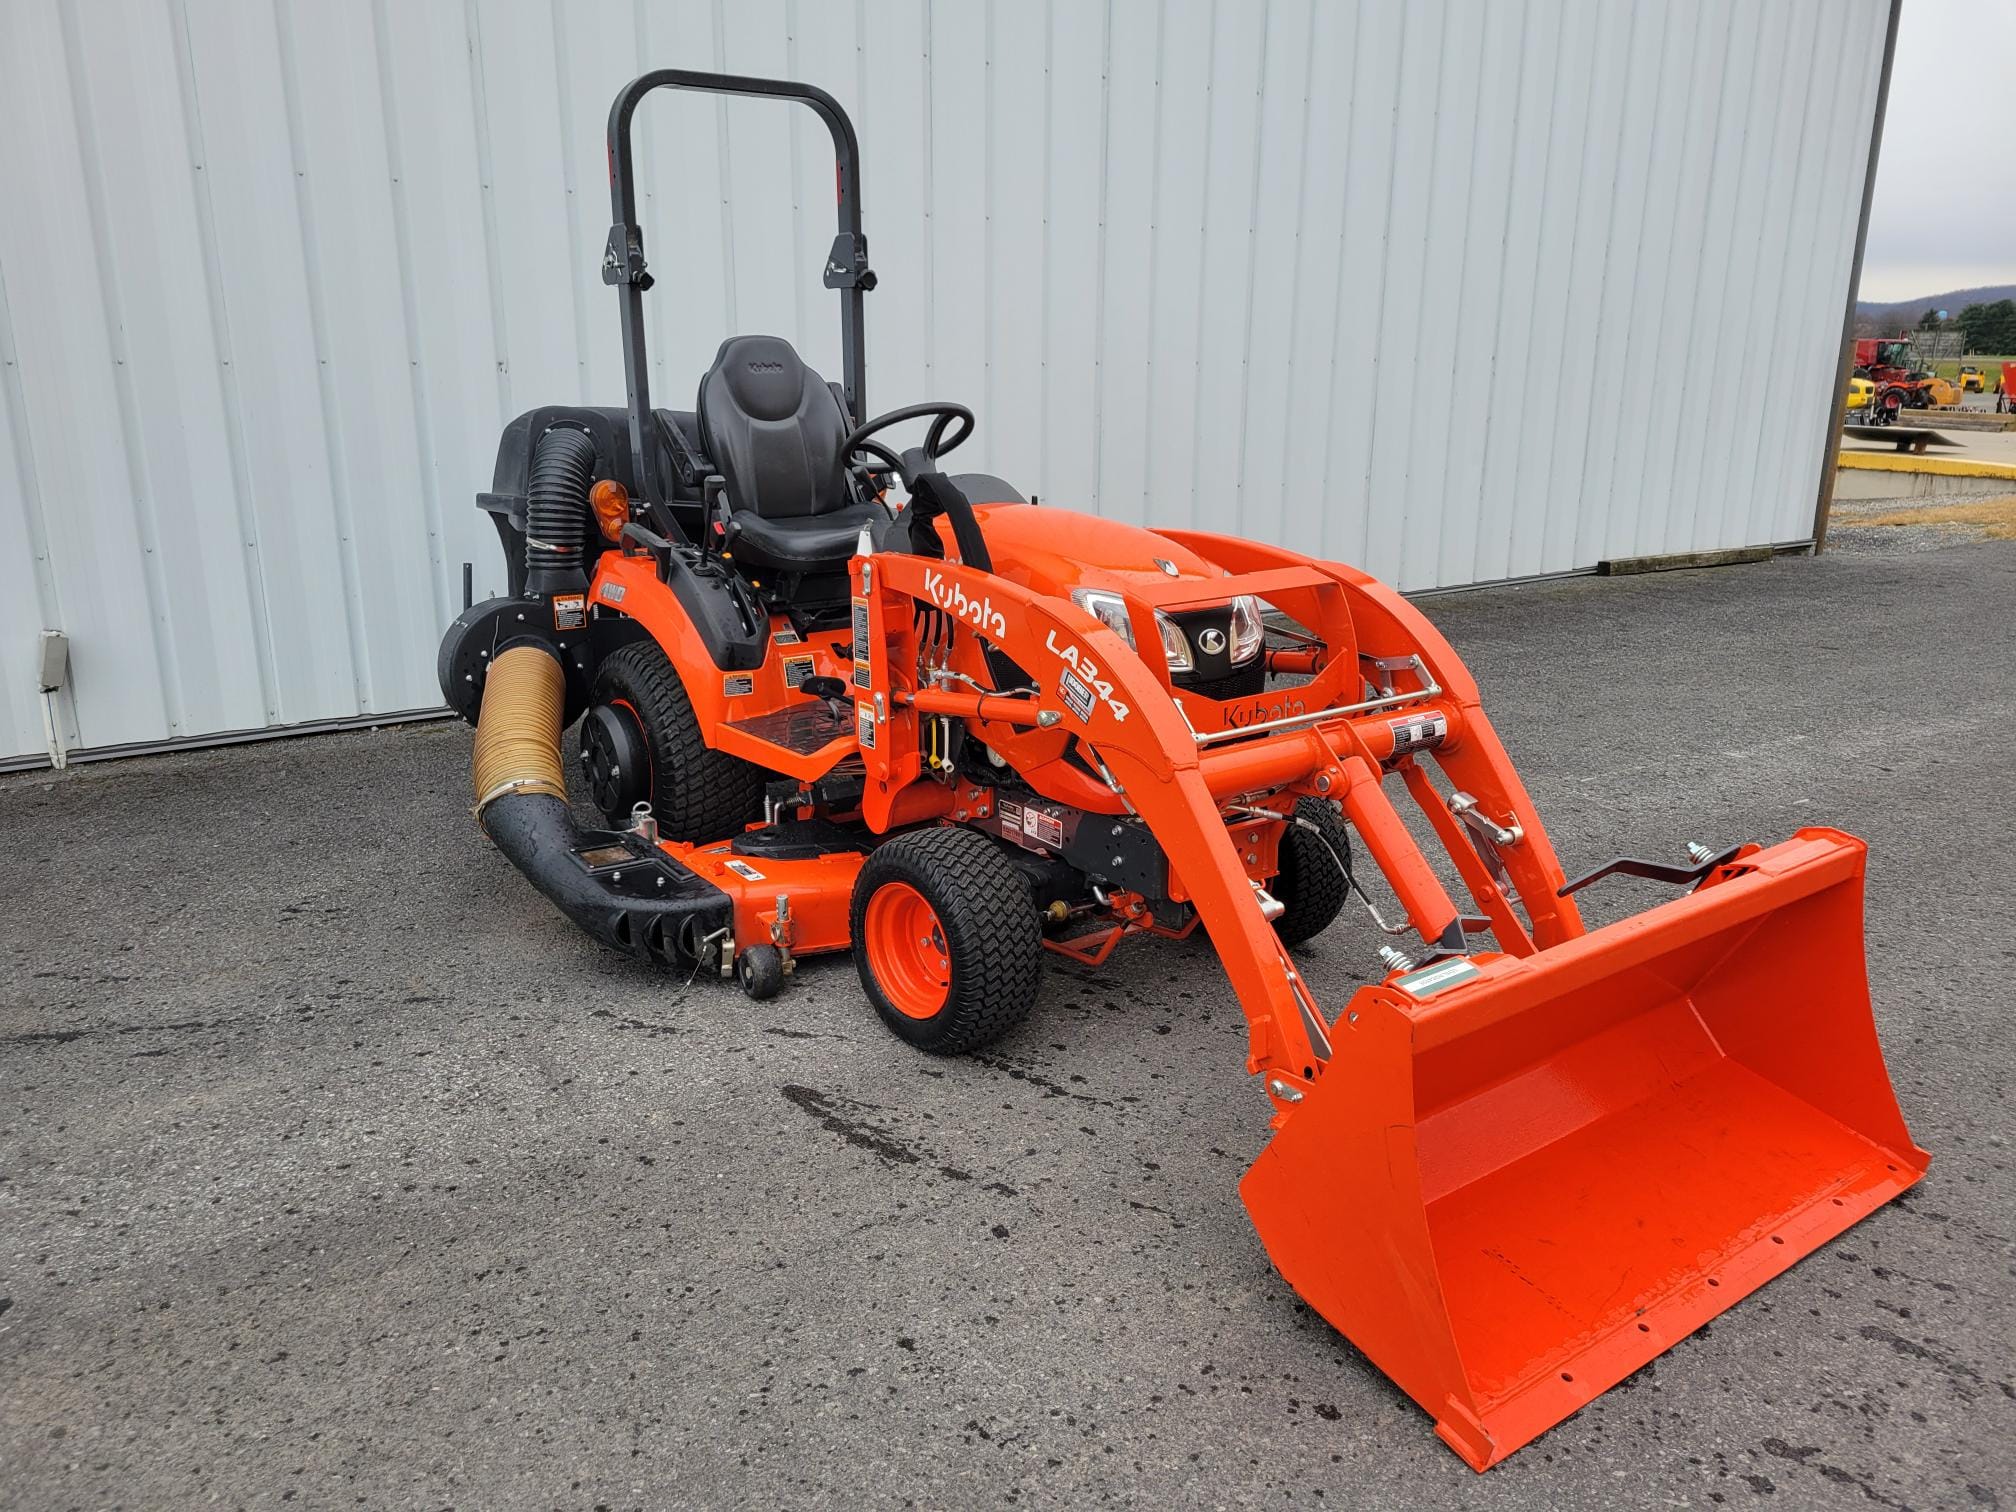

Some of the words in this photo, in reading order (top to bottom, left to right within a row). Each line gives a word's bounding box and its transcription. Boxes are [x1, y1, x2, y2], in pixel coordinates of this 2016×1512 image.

[601, 582, 626, 602] 4WD
[924, 568, 1006, 638] Kubota
[1046, 629, 1130, 722] LA344
